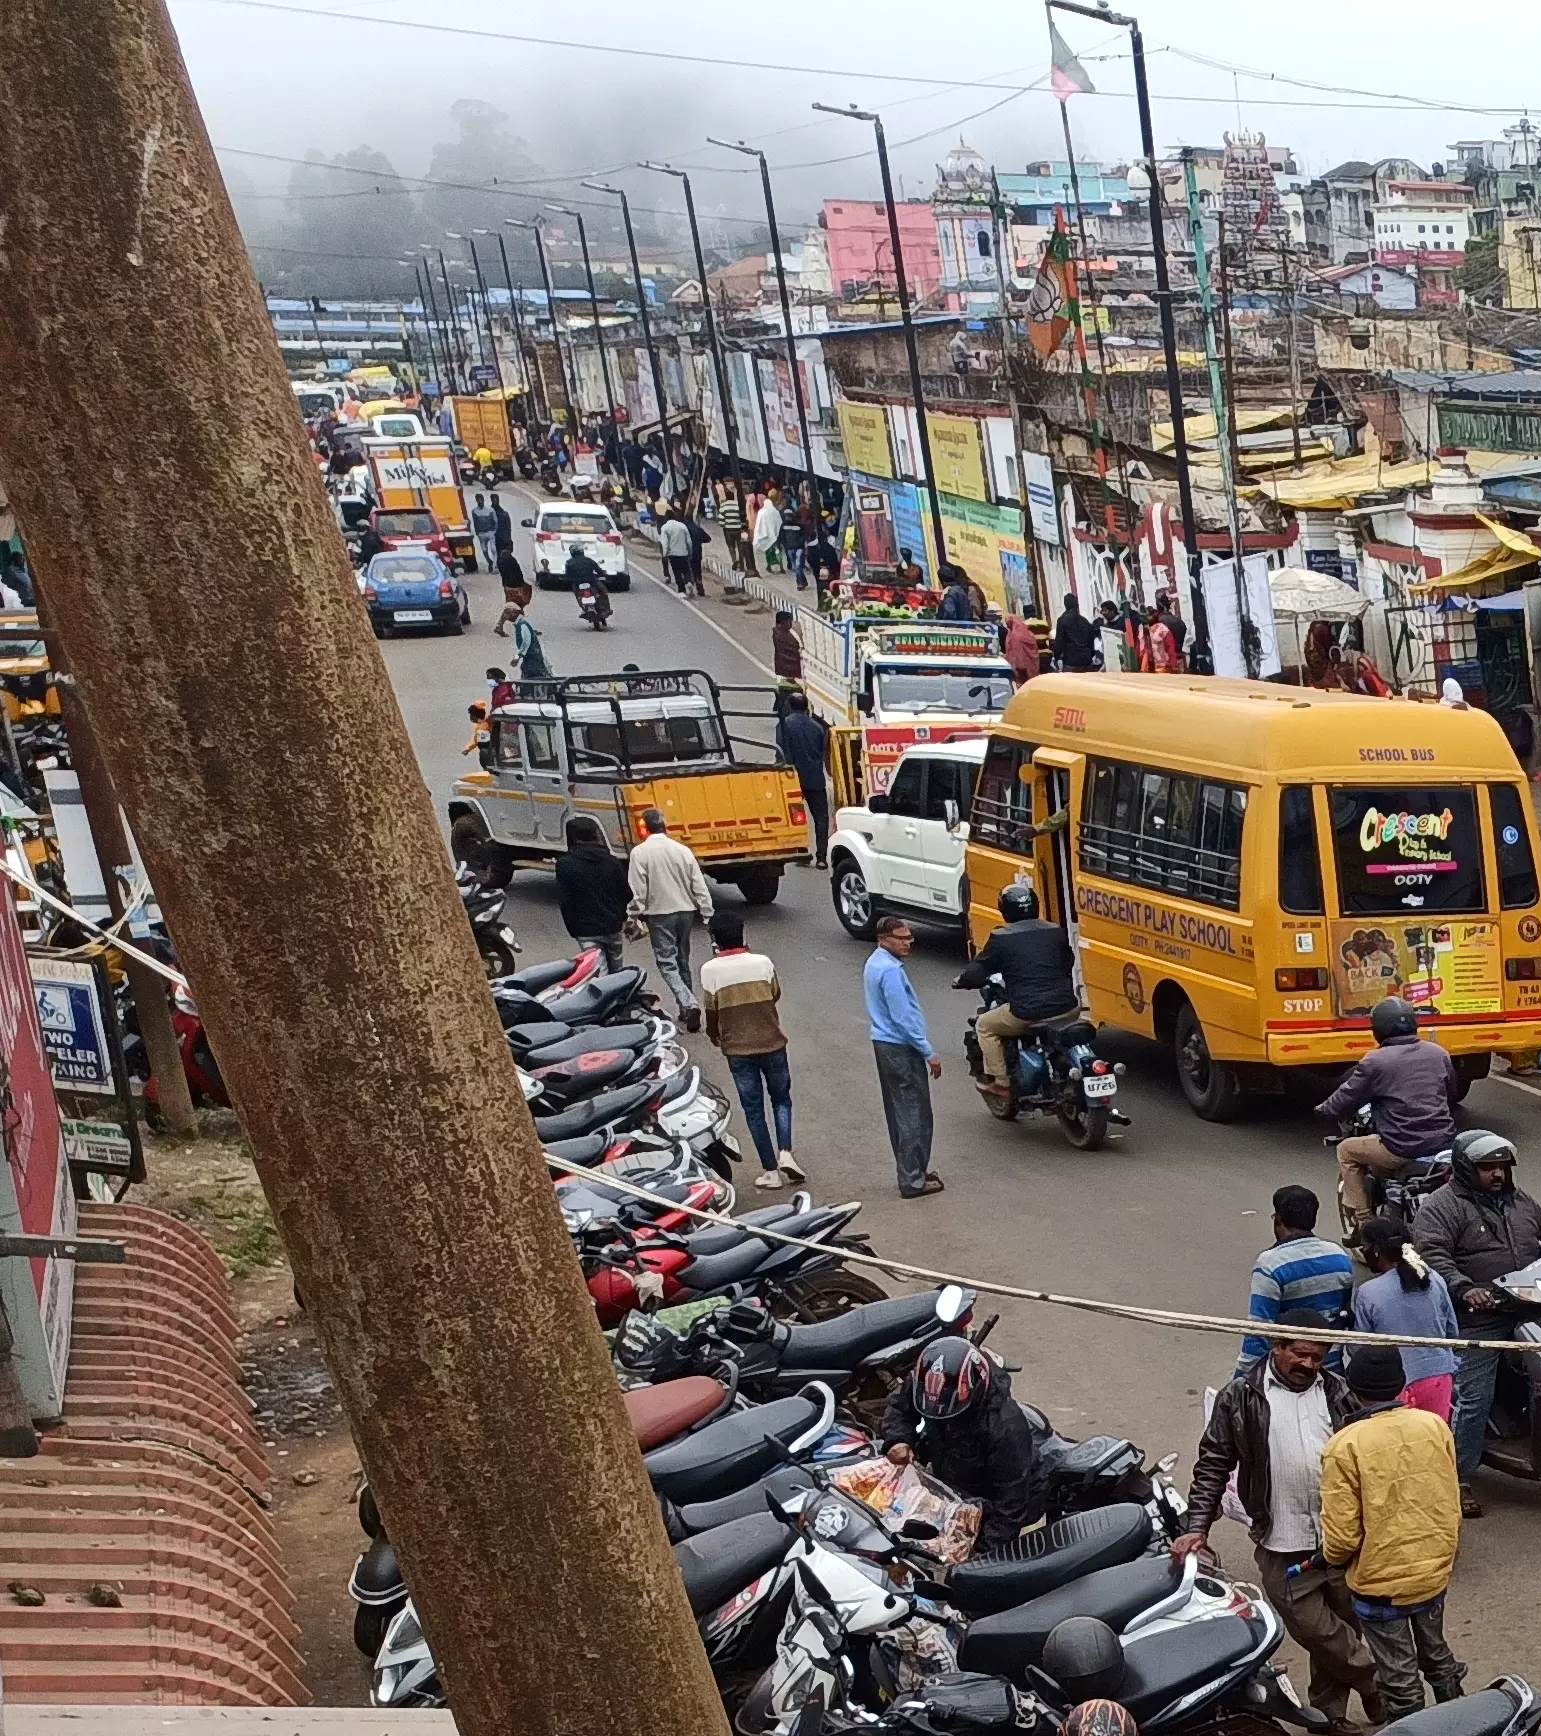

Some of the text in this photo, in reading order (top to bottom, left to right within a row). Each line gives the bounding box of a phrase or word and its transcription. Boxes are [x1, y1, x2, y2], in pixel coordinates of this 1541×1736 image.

[1359, 748, 1435, 761] SCHOOL BUS
[1360, 807, 1454, 851] Crescent
[1394, 873, 1433, 886] OOTY
[1077, 886, 1141, 924] CRESCENT
[1144, 905, 1176, 937] PLAY
[1180, 914, 1236, 954] SCHOOL
[1283, 998, 1323, 1013] STOP
